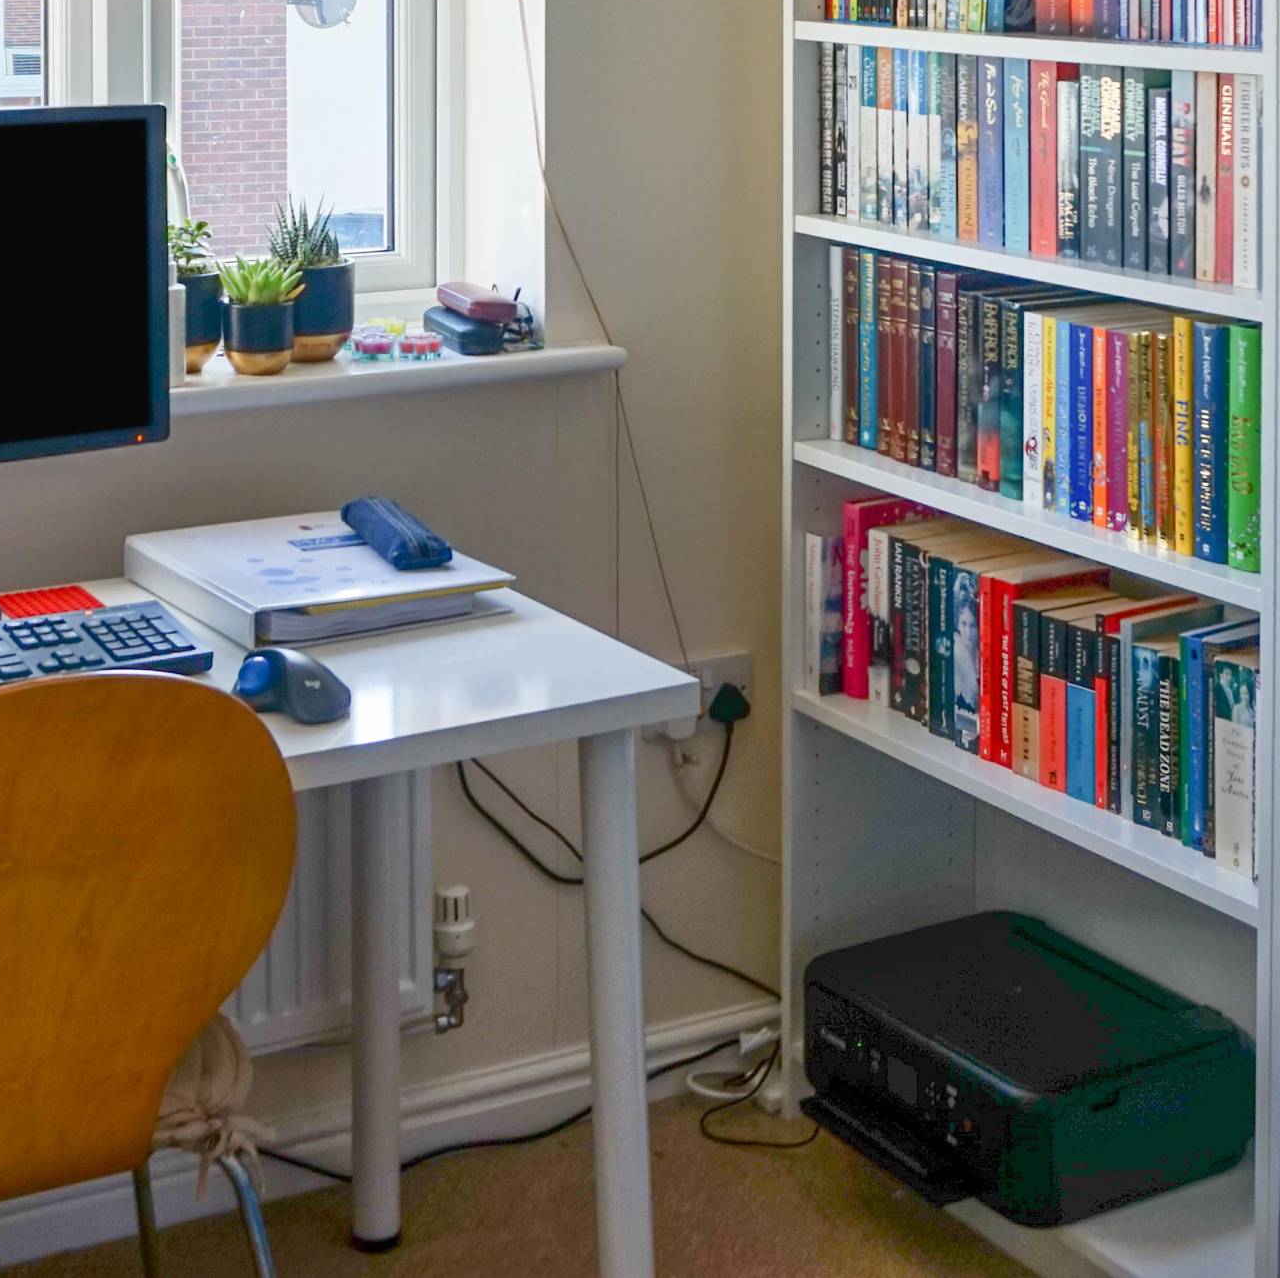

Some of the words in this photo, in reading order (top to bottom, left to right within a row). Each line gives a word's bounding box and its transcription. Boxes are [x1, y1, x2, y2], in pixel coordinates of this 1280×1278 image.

[1081, 75, 1091, 138] CONNELLY
[1101, 77, 1111, 140] CONNELLY
[1110, 82, 1120, 135] MICHAEL
[1125, 78, 1135, 141] CONNELLY
[1135, 83, 1144, 138] MICHAEL
[1155, 97, 1166, 137] MICHAEL
[1222, 85, 1232, 156] GENERALS
[1241, 81, 1250, 132] FIGHTER
[1173, 102, 1191, 167] D-DAY
[1241, 137, 1250, 169] BOYS
[1088, 158, 1097, 175] The
[1107, 159, 1116, 183] Nine
[1131, 162, 1140, 180] The
[1155, 140, 1166, 186] CONNELLY
[1088, 177, 1097, 202] Black
[1105, 186, 1115, 227] Dragons
[1131, 182, 1140, 200] Last
[1177, 174, 1185, 200] GILES
[1088, 204, 1096, 228] Echo
[1130, 202, 1140, 236] Coyote
[1177, 202, 1186, 234] MILTON
[983, 303, 997, 362] EMPEROR
[1006, 312, 1018, 369] EMPEROR
[1077, 386, 1087, 432] DEMON
[1176, 400, 1189, 446] FING
[894, 542, 902, 563] IAN
[894, 565, 902, 608] RANKIN
[1001, 653, 1009, 676] BOOK
[1001, 678, 1008, 688] OF
[1017, 656, 1033, 705] ANNA
[1001, 690, 1009, 710] LOST
[1136, 671, 1149, 731] ANALYST
[1159, 679, 1170, 709] THE
[1001, 712, 1009, 744] THINGS
[1159, 711, 1170, 752] DEAD
[1160, 754, 1170, 793] ZONE
